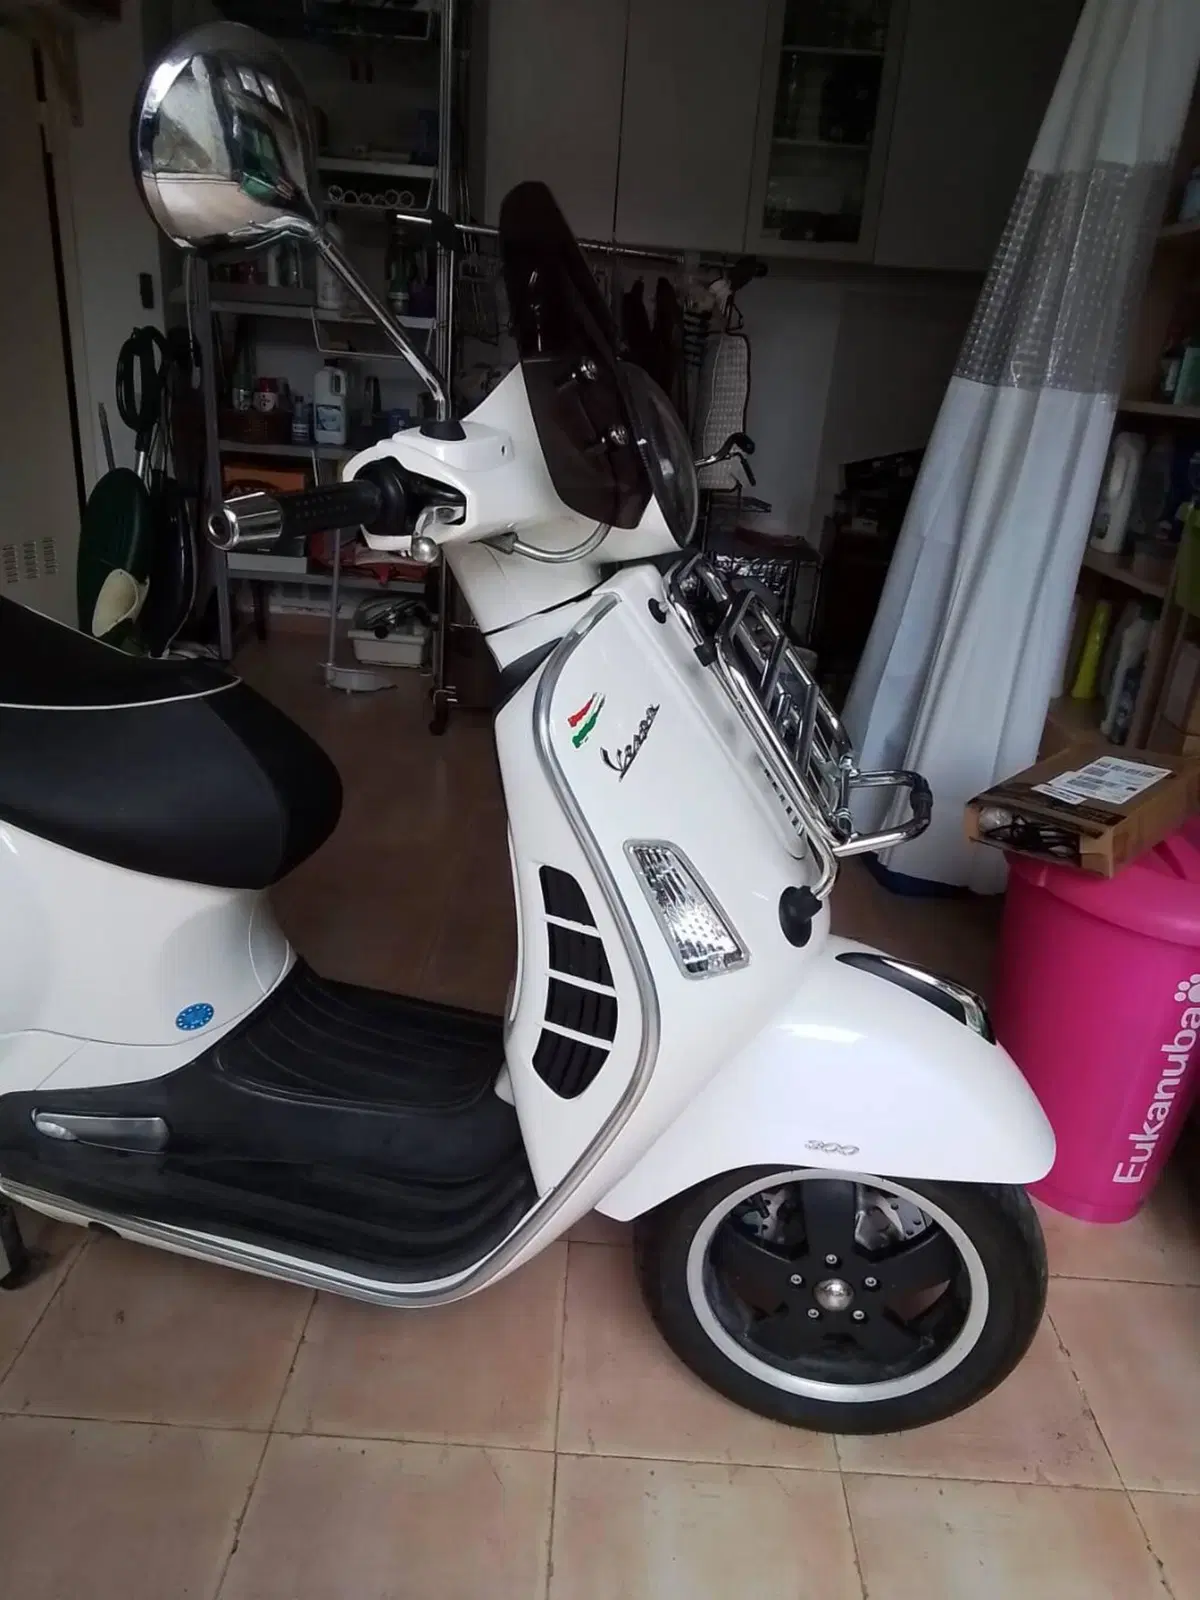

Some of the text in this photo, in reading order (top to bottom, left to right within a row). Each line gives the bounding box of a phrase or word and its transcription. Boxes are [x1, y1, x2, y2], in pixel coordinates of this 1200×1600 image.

[600, 704, 660, 782] Vespa
[1112, 1007, 1200, 1184] Eukanuba
[804, 1139, 860, 1156] 300
